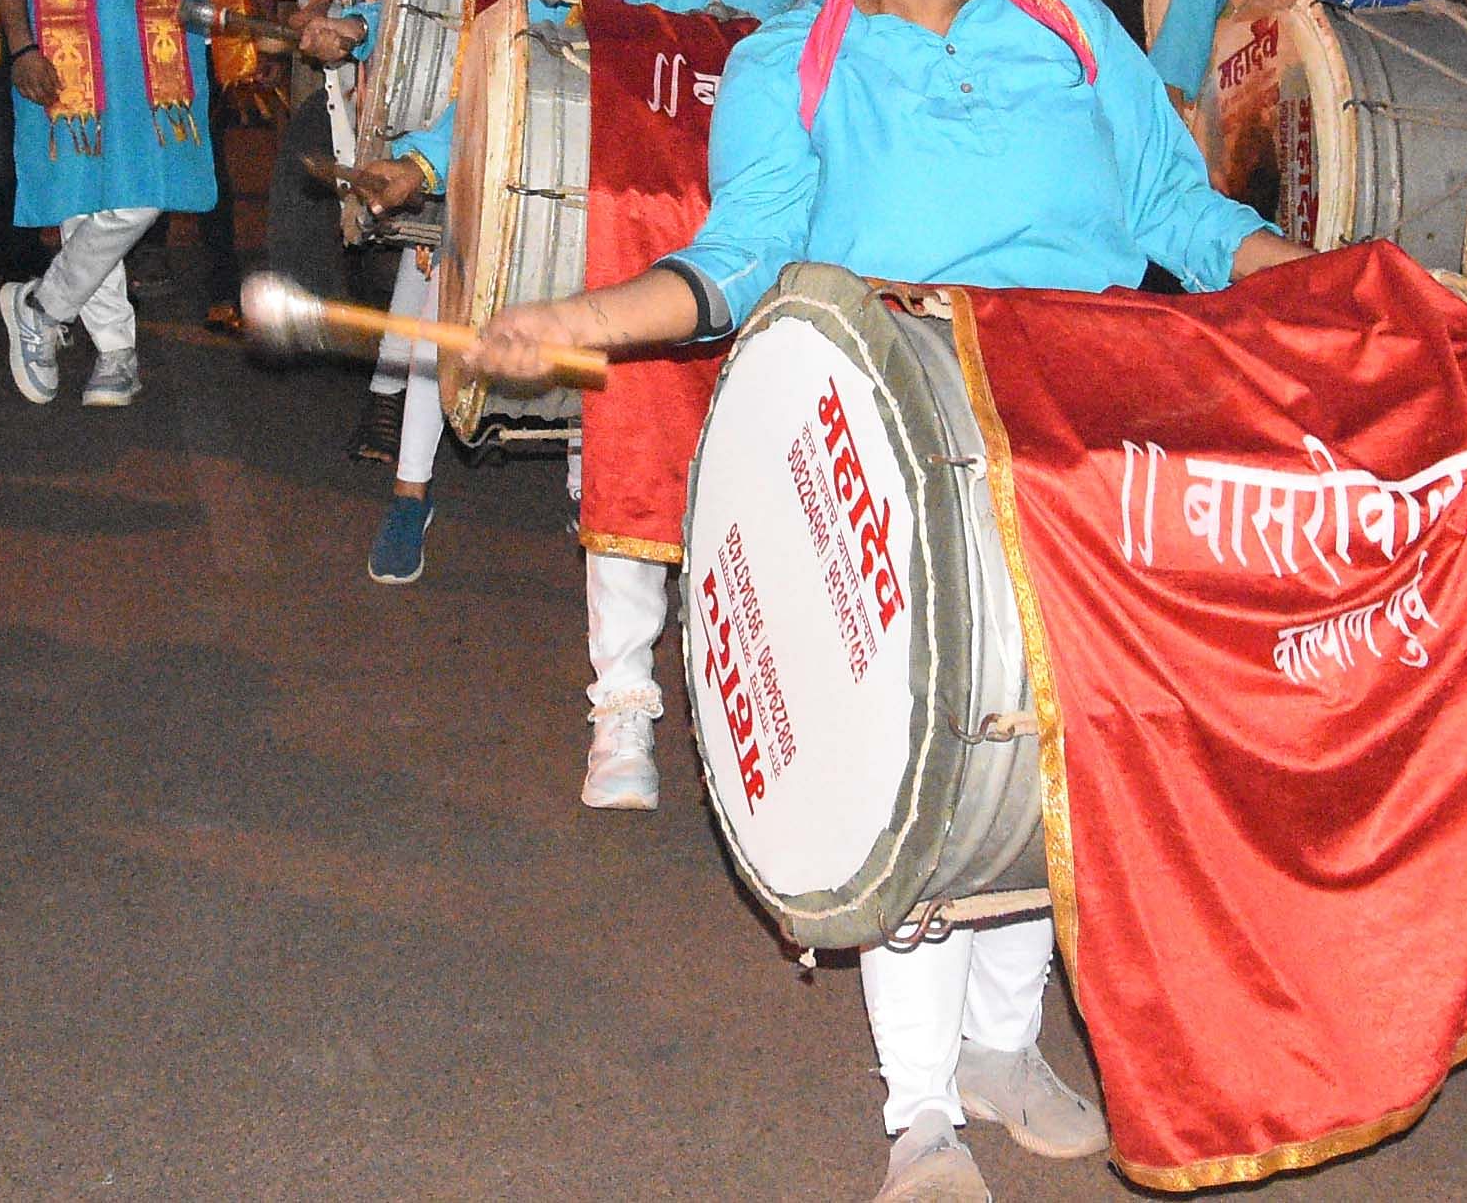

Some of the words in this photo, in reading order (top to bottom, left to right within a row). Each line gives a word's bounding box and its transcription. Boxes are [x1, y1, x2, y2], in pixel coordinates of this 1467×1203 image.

[818, 375, 904, 634] महादेव
[718, 545, 738, 606] कल्याण
[725, 523, 764, 642] 9930437426
[856, 595, 878, 659] कल्याण
[695, 570, 765, 816] महादेव
[1273, 601, 1384, 685] कल्याण
[758, 645, 797, 766] 9082294990
